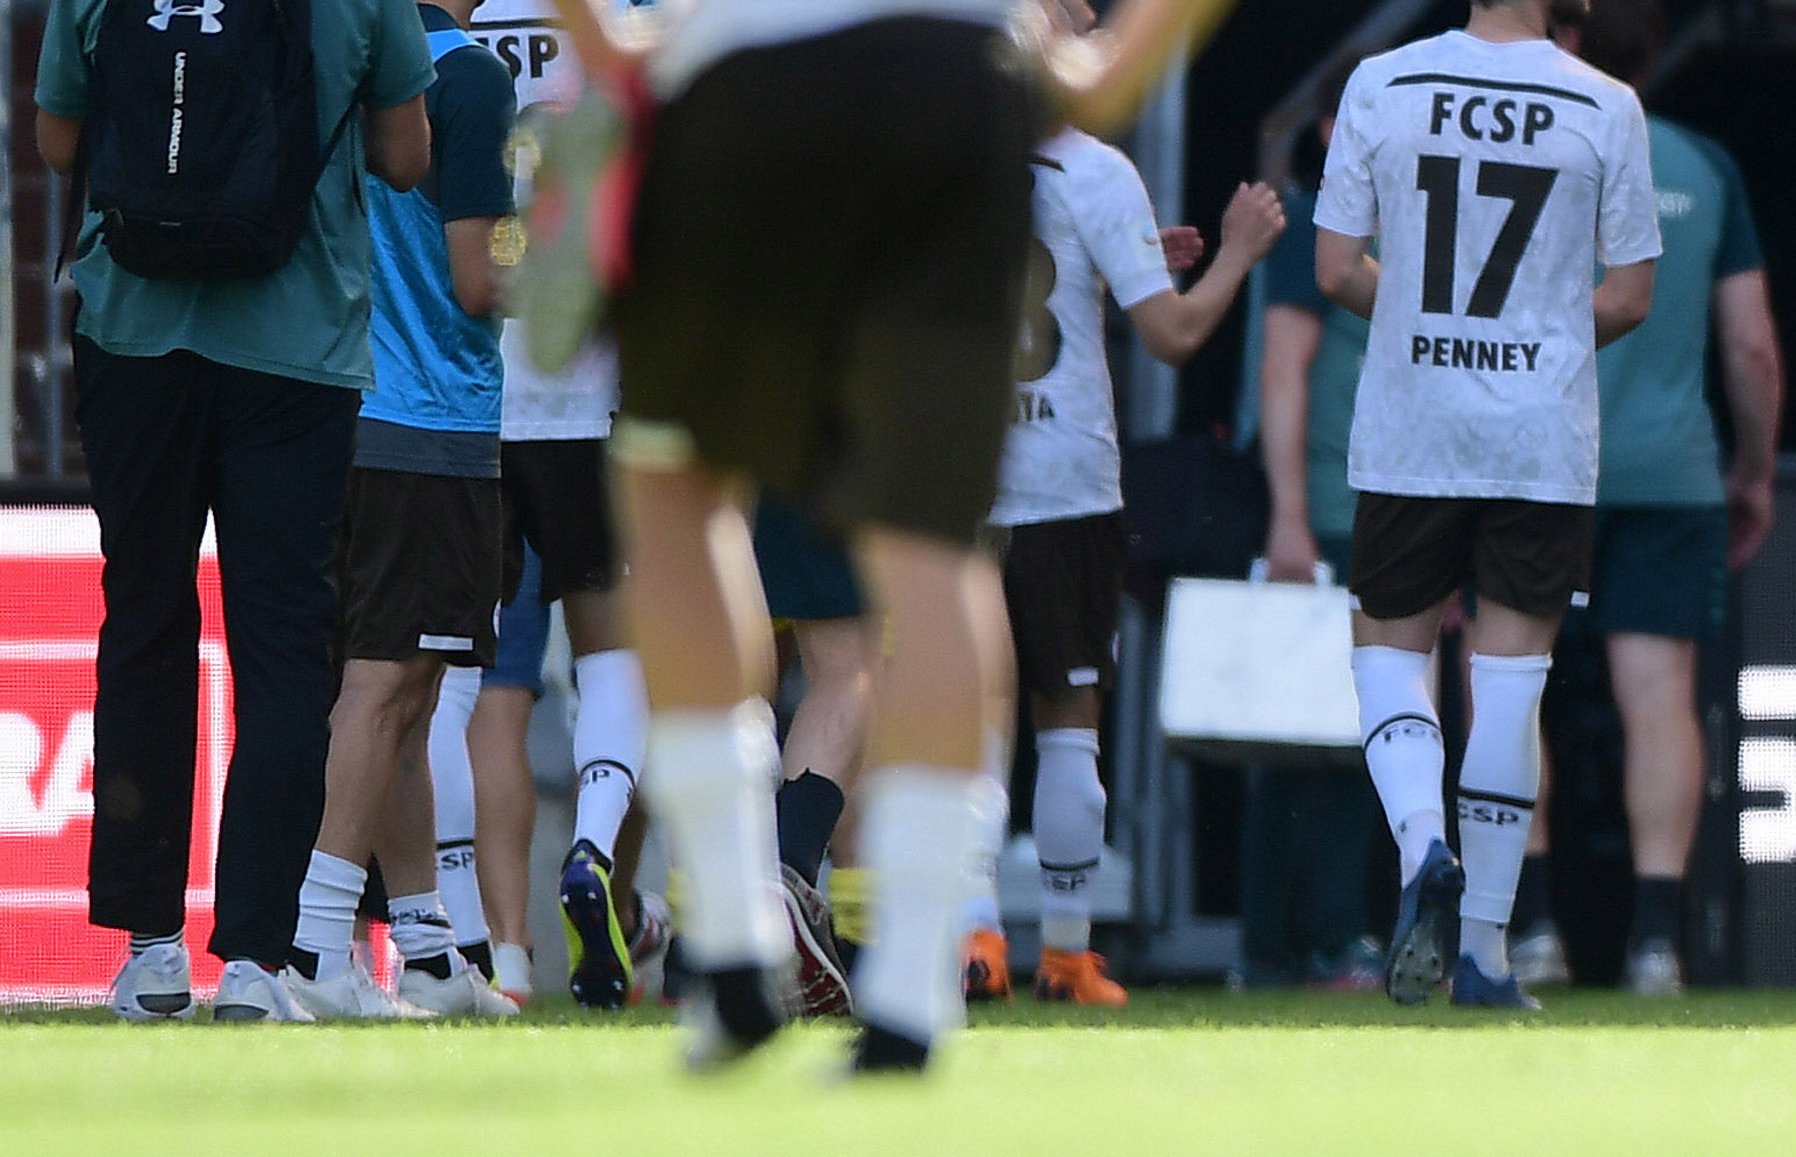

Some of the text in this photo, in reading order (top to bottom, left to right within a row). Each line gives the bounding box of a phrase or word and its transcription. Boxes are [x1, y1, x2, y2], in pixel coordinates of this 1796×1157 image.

[474, 34, 559, 79] SP
[167, 51, 187, 174] UNDER ARMOUR
[1429, 92, 1554, 146] FCSP
[1416, 154, 1560, 319] 17
[1411, 335, 1541, 372] PENNEY
